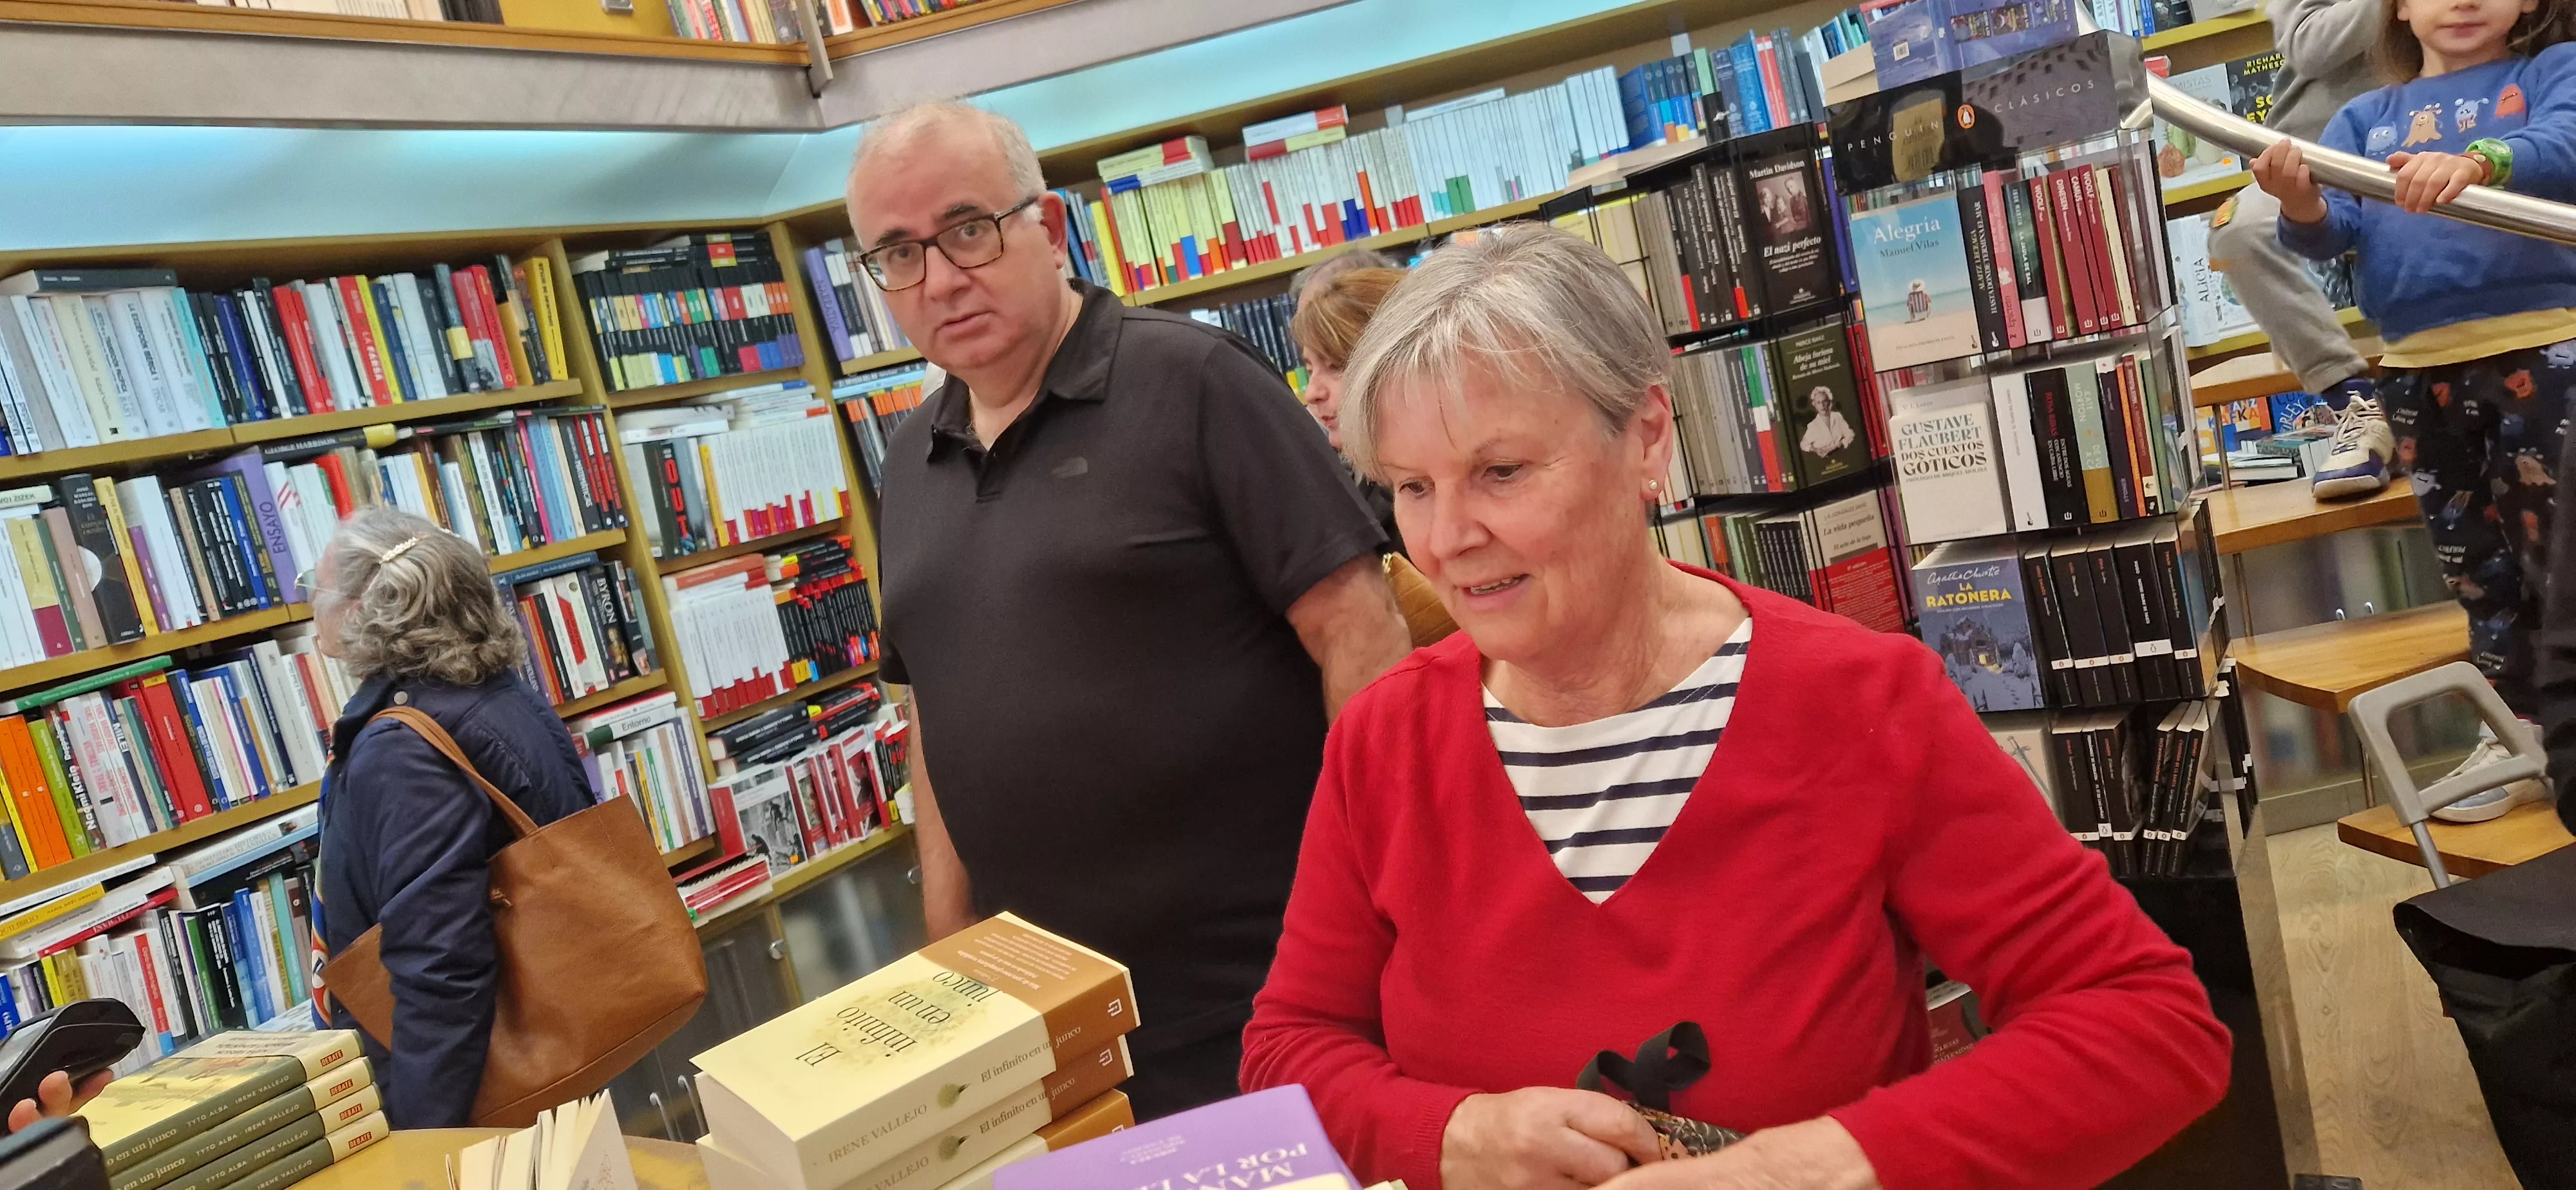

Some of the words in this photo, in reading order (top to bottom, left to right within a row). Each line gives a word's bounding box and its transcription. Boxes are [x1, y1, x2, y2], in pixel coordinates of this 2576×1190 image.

[1994, 80, 2094, 113] CLÁSICOS
[1848, 120, 1939, 152] PENGUIN
[1748, 165, 1774, 180] Martin
[1774, 160, 1805, 174] Davidson
[2052, 178, 2071, 211] DINESEN
[2069, 175, 2084, 202] CAMUS
[2081, 171, 2096, 199] WOOLF
[2031, 184, 2048, 212] WOOLF
[1873, 216, 1941, 245] Alegría
[2018, 232, 2024, 240] LA
[1764, 245, 1772, 257] El
[1774, 241, 1790, 254] nazi
[1792, 236, 1821, 252] perfecto
[1880, 245, 1914, 258] Manuel
[1916, 238, 1940, 252] Vilas
[1970, 229, 1980, 263] LECEAGA
[2018, 241, 2029, 261] JAULA
[1975, 264, 1985, 290] ALAITZ
[1983, 262, 1993, 290] DONDE
[2022, 261, 2031, 271] DE
[2023, 271, 2033, 285] SAL
[814, 278, 840, 334] NARRATIVA
[2002, 295, 2016, 328] Epicteto
[360, 330, 373, 345] LA
[1793, 352, 1812, 364] Abeja
[1812, 348, 1833, 358] furiosa
[1817, 355, 1831, 366] miel
[2044, 391, 2055, 413] ROSA
[2070, 381, 2087, 422] MORTON
[2082, 390, 2094, 411] KATE
[1901, 413, 1974, 436] GUSTAVE
[2047, 413, 2059, 436] RIBAS
[263, 443, 296, 455] GEORGE
[295, 435, 336, 450] HARRISON
[1899, 426, 1982, 451] FLAUBERT
[2046, 440, 2053, 449] EN
[2058, 438, 2068, 457] ENTRE
[2091, 444, 2101, 455] DE
[1901, 449, 1925, 462] DOS
[1927, 440, 1984, 457] CUENTOS
[2061, 457, 2070, 469] DOS
[1903, 452, 1987, 476] GÓTICOS
[2054, 452, 2065, 478] ANUNCIO
[2063, 469, 2072, 487] AGUAS
[2120, 477, 2129, 502] STONER
[258, 499, 286, 555] ENSAYO
[1823, 527, 1832, 536] La
[1833, 522, 1847, 532] vida
[1848, 514, 1875, 529] pequeña
[1963, 565, 2000, 580] Christie
[1926, 587, 2012, 607] RATONERA
[1959, 582, 1973, 591] LA
[596, 576, 618, 623] BYRON
[621, 715, 652, 732] Entorno
[111, 721, 129, 753] MILEI
[66, 764, 84, 794] Klein
[77, 792, 97, 831] Naomi
[932, 970, 1000, 1008] junco
[888, 990, 925, 1014] un
[916, 1004, 951, 1024] en
[837, 1006, 918, 1058] infinito
[321, 1049, 343, 1067] DEBATE
[795, 1041, 843, 1068] El
[979, 1069, 994, 1082] El
[990, 1050, 1029, 1077] infinito
[1028, 1046, 1042, 1058] en
[1055, 1024, 1083, 1048] junco
[330, 1079, 354, 1096] DEBATE
[339, 1104, 362, 1120] DEBATE
[977, 1120, 992, 1134] El
[988, 1101, 1027, 1128] infinito
[1025, 1097, 1039, 1108] en
[1051, 1075, 1076, 1099] junco
[116, 1149, 130, 1162] en
[132, 1142, 146, 1155] un
[147, 1127, 177, 1148] junco
[187, 1114, 206, 1128] TYTO
[209, 1103, 229, 1118] ALBA
[234, 1091, 256, 1105] IRENE
[258, 1074, 290, 1094] VALLEJO
[139, 1172, 154, 1185] un
[155, 1157, 185, 1178] junco
[194, 1142, 216, 1157] TYTO
[218, 1133, 238, 1147] ALBA
[244, 1120, 265, 1135] IRENE
[268, 1104, 300, 1122] VALLEJO
[348, 1131, 372, 1149] DEBATE
[826, 1133, 871, 1163] IRENE
[869, 1103, 930, 1140] VALLEJO
[206, 1169, 226, 1184] TYTO
[228, 1159, 247, 1174] ALBA
[253, 1146, 275, 1161] IRENE
[276, 1129, 309, 1148] VALLEJO
[257, 1175, 278, 1190] IRENE
[280, 1158, 313, 1178] VALLEJO
[875, 1156, 930, 1190] VALLEJO
